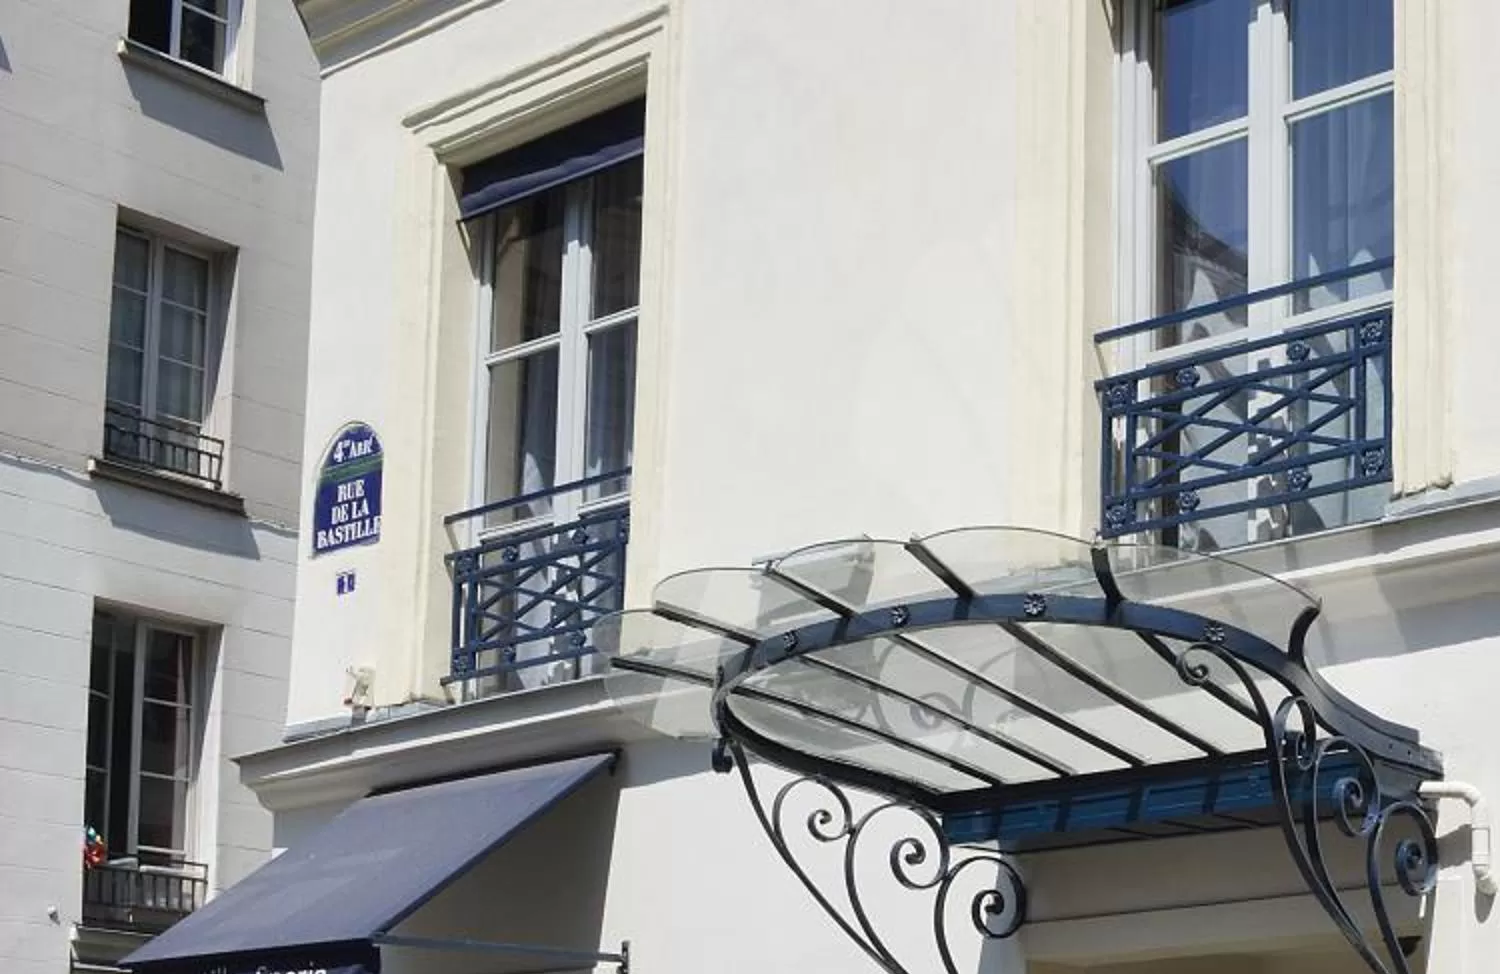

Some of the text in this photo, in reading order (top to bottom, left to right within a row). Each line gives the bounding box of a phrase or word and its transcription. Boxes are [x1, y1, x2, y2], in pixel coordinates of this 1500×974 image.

[337, 479, 365, 503] RUE
[331, 498, 370, 525] DE LA
[316, 515, 382, 550] BASTILLE
